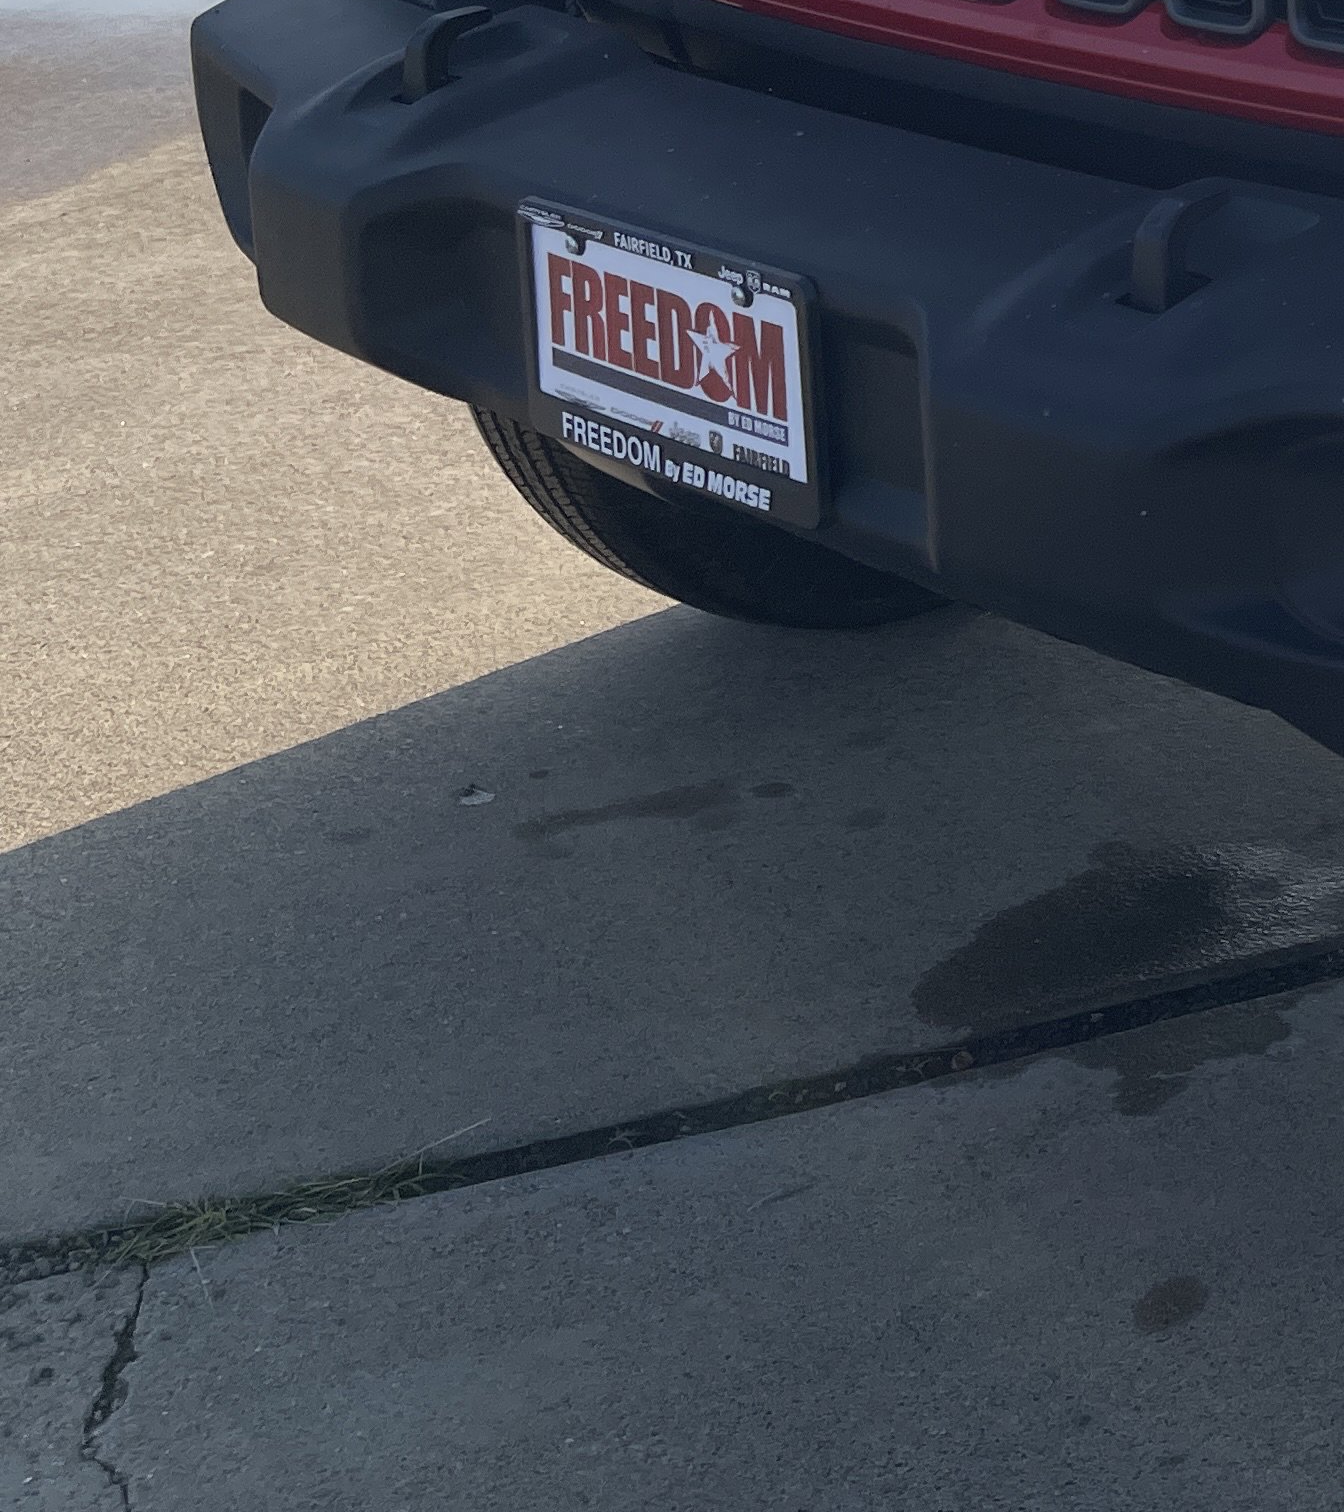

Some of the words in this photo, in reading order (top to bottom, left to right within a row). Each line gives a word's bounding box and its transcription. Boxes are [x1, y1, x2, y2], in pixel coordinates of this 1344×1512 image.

[613, 231, 673, 267] FAIRFIELD,
[674, 250, 694, 270] TX
[717, 265, 744, 286] Jeep
[762, 282, 791, 299] RAM
[546, 251, 789, 423] FREEDOM
[728, 411, 740, 427] BY
[754, 420, 786, 442] MORSE
[561, 410, 662, 473] FREEDOM
[681, 461, 706, 487] ED
[707, 470, 772, 512] MORSE
